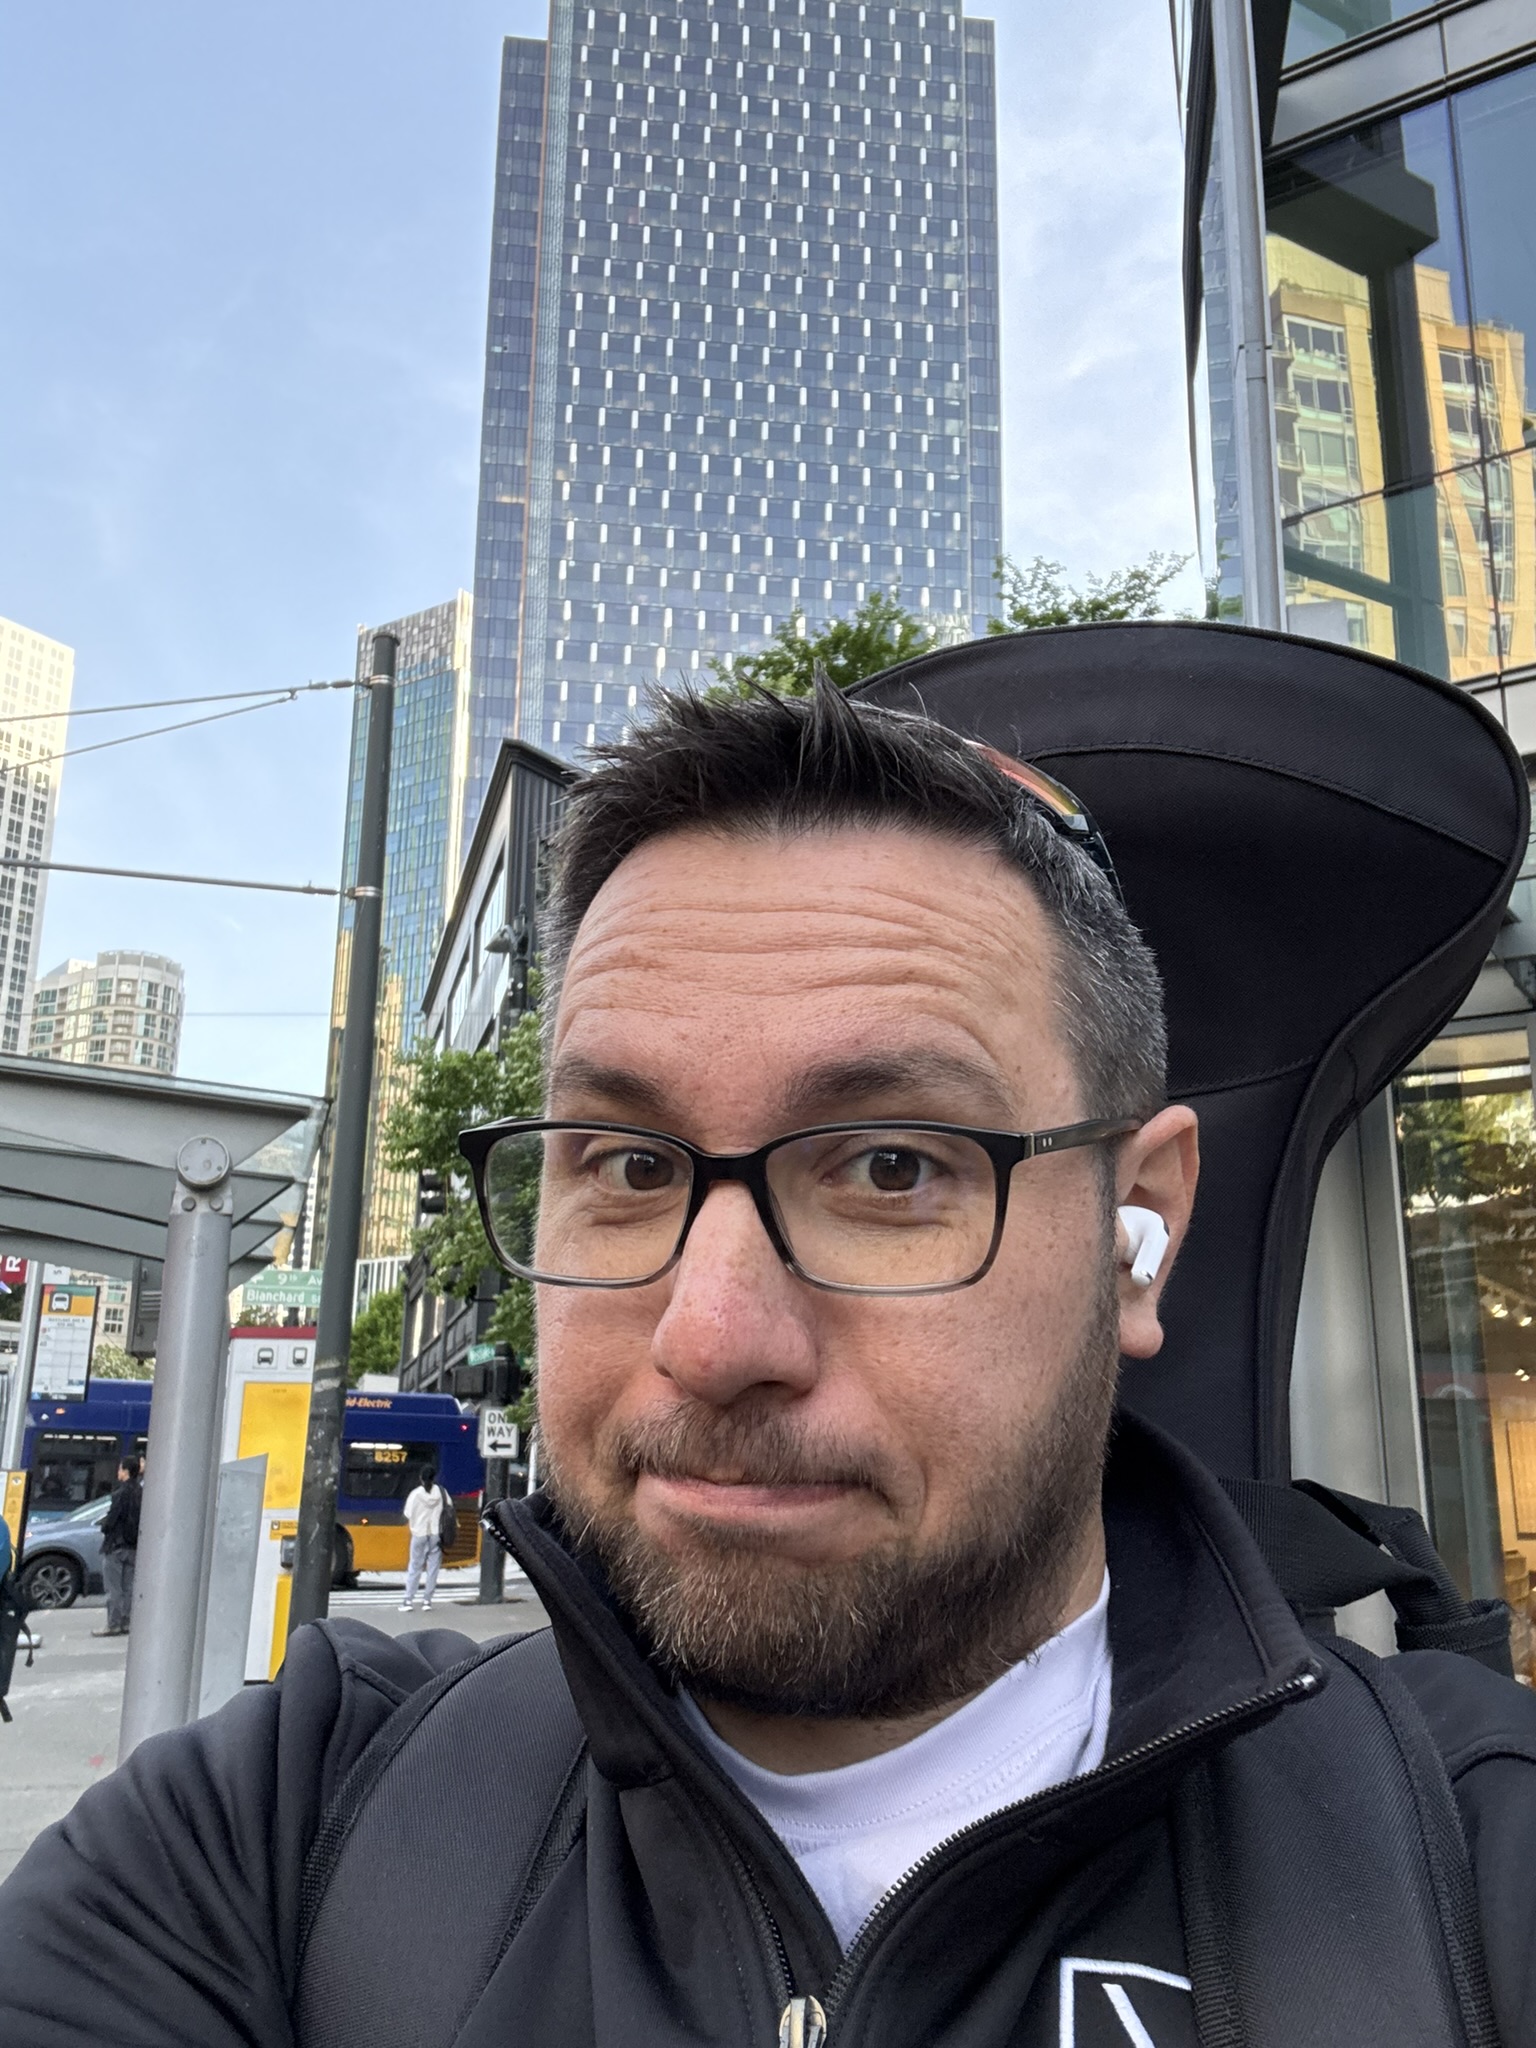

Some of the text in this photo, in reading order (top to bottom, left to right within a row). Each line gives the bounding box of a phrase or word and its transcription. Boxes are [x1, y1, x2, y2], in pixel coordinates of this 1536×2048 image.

[247, 1289, 305, 1303] Blanchard
[345, 1397, 392, 1408] id-Electric
[488, 1412, 506, 1424] ON
[487, 1426, 514, 1439] WAY
